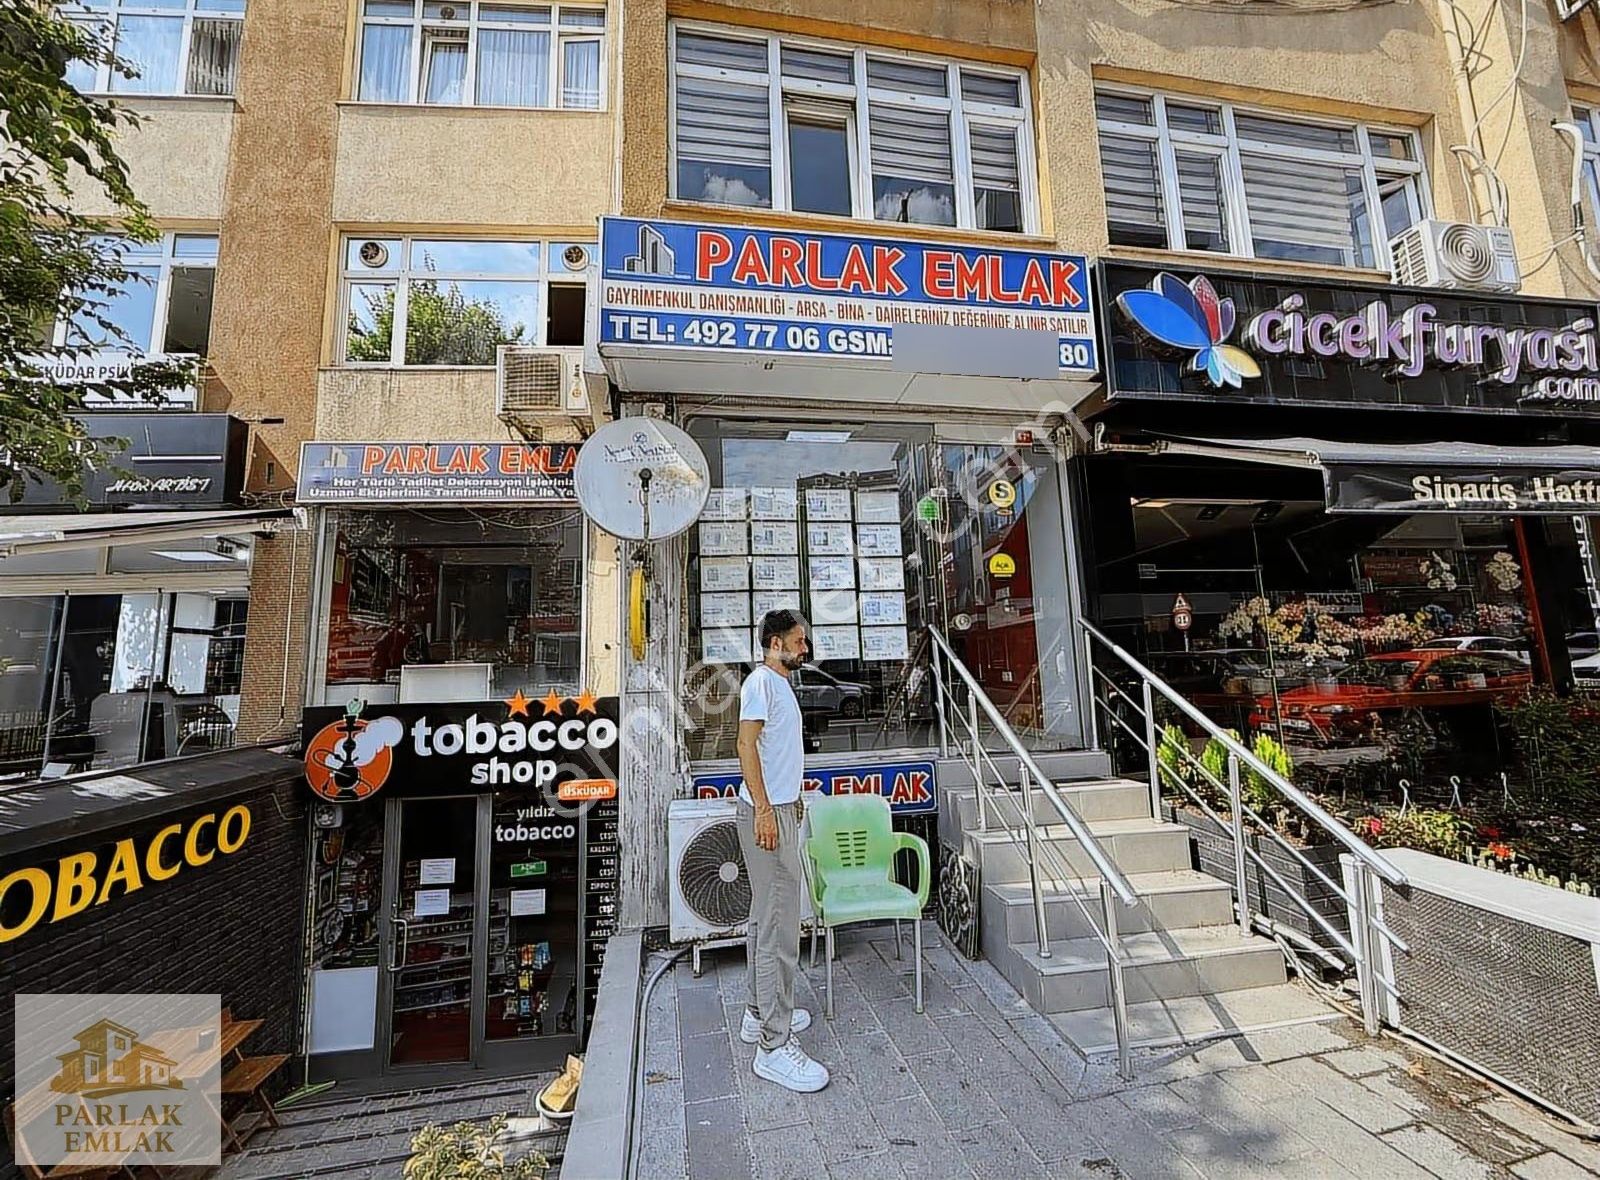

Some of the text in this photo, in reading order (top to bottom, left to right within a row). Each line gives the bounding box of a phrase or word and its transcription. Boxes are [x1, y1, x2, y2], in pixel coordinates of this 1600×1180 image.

[696, 231, 1083, 307] PARLAK EMLAK
[606, 286, 695, 310] GAYRİMENKUL
[700, 293, 786, 316] DANIŞMANLIĞI
[796, 301, 827, 318] ARSA
[838, 300, 864, 321] BİNA
[876, 302, 949, 325] DAİRELERİNİZ
[1050, 317, 1088, 334] SATILIR
[609, 315, 676, 342] TEL:
[684, 319, 736, 346] 492
[744, 323, 779, 348] 77
[786, 327, 819, 351] 06
[1060, 343, 1089, 366] 80
[362, 445, 577, 475] PARLAK EMLA
[309, 487, 354, 497] Uzman
[358, 487, 431, 499] Ekiplerimiz
[434, 487, 505, 497] Tarafından
[333, 477, 357, 487] Her
[447, 477, 521, 489] Dekorasyon
[995, 482, 1009, 498] S
[1412, 475, 1518, 510] Sipariş
[411, 713, 618, 757] tobacco
[471, 756, 557, 787] shop
[564, 784, 610, 796] ÜSKÜDAR
[517, 805, 556, 821] yıldız
[495, 824, 575, 842] tobacco
